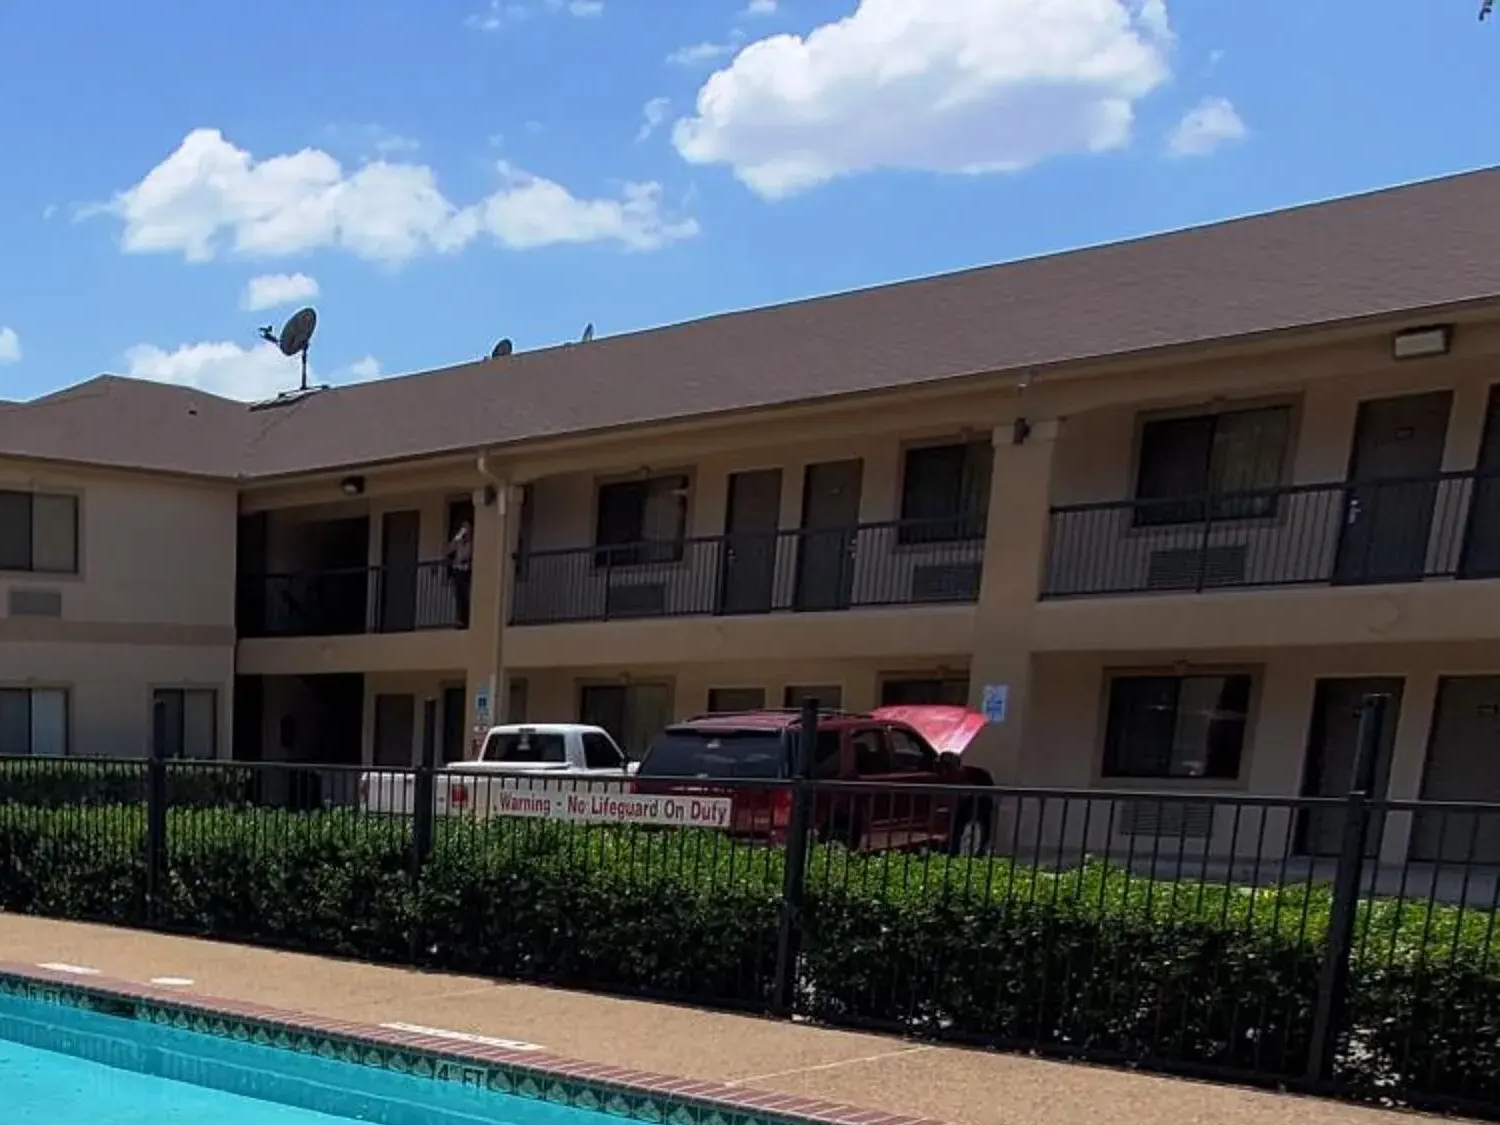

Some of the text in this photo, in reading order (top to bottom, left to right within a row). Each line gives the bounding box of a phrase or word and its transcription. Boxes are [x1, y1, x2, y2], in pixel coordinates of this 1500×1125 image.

[500, 792, 551, 816] Warning
[567, 795, 586, 814] No
[591, 796, 658, 819] Lifeguard
[664, 799, 685, 819] On
[690, 800, 727, 825] Duty
[437, 1064, 484, 1087] 4 FT
